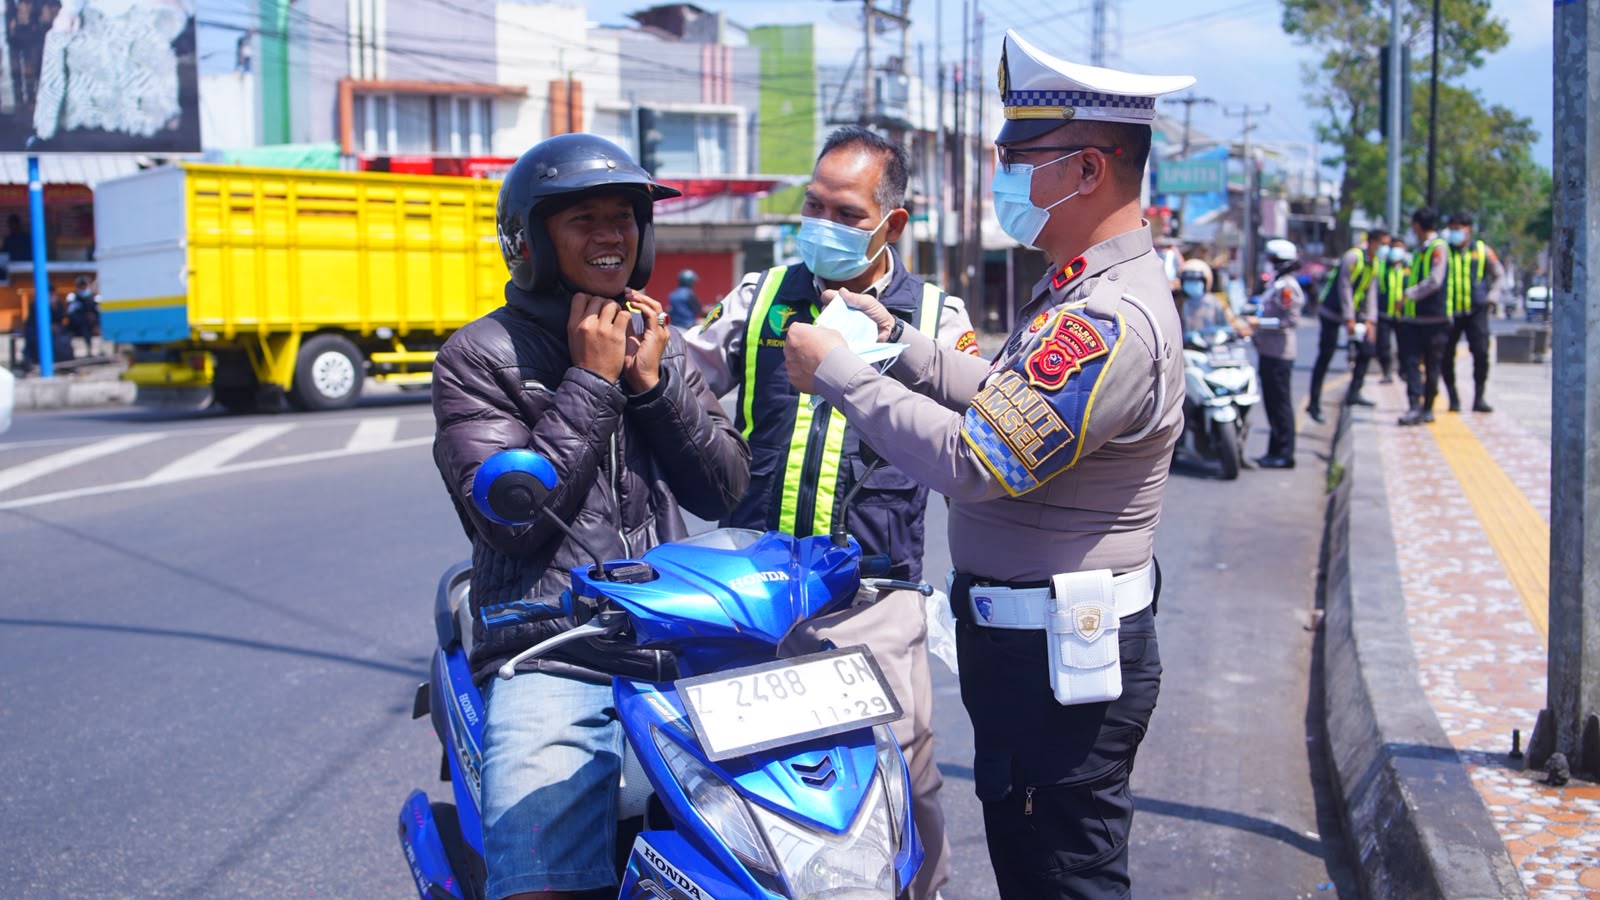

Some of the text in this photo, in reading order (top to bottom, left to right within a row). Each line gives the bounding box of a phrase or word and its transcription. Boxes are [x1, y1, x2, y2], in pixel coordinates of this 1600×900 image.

[1066, 320, 1097, 348] POLRES
[728, 570, 790, 590] HONDA
[728, 669, 807, 707] 2488
[833, 656, 875, 686] GN
[458, 692, 480, 727] HONDA
[643, 846, 701, 900] HONDA
